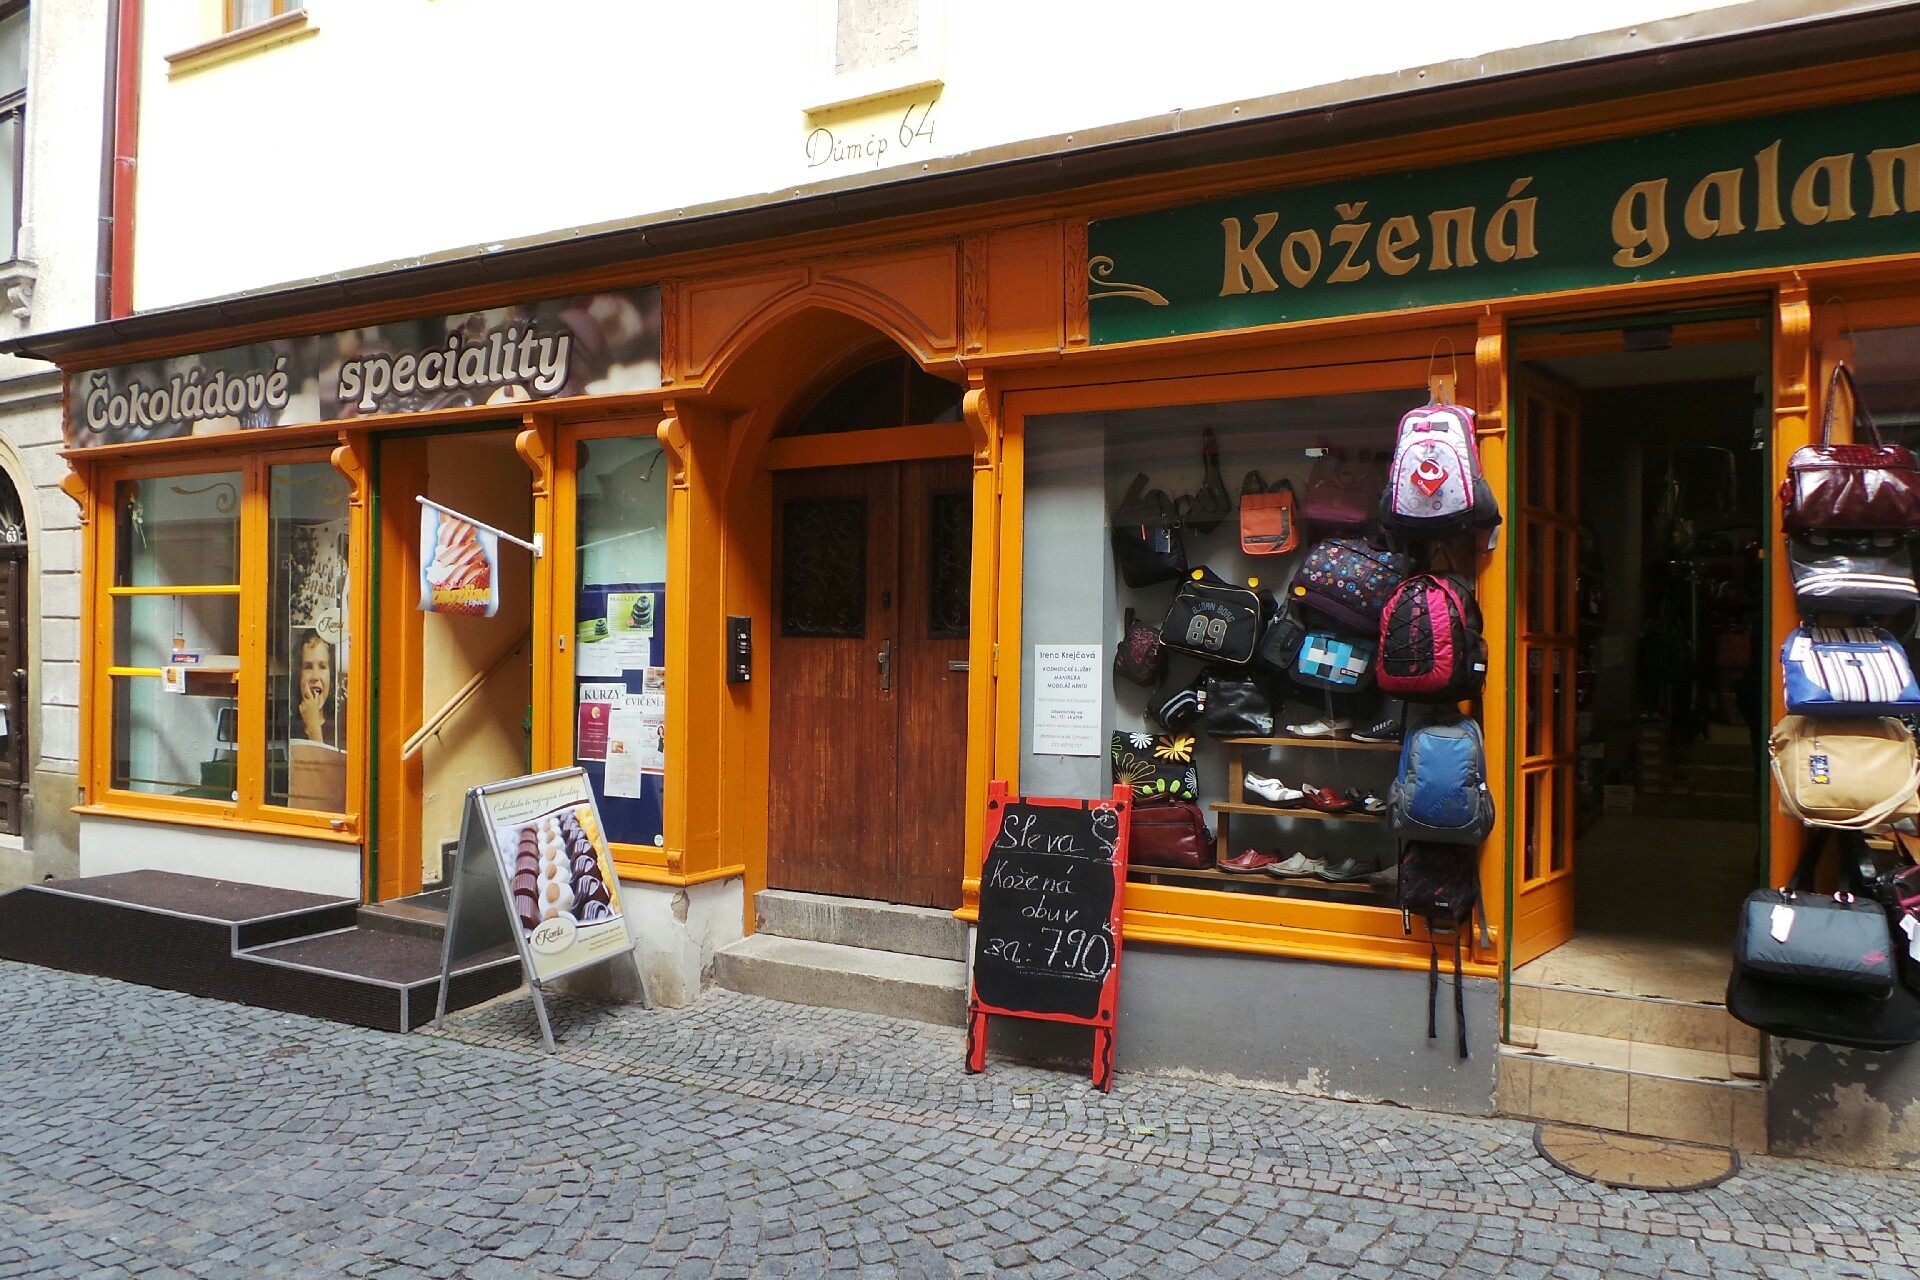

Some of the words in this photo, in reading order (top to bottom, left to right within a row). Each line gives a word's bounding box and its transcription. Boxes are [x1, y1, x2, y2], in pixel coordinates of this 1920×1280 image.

[899, 100, 936, 149] 64
[1219, 176, 1539, 298] Kožená
[86, 356, 290, 432] Čokoládové
[337, 326, 570, 410] speciality
[1186, 615, 1228, 651] 89
[1061, 650, 1096, 661] Krejčová
[584, 688, 621, 700] KURZY
[994, 814, 1084, 853] Sleva
[989, 858, 1076, 895] Kožená
[1021, 895, 1079, 924] obuv
[1041, 926, 1110, 977] 790
